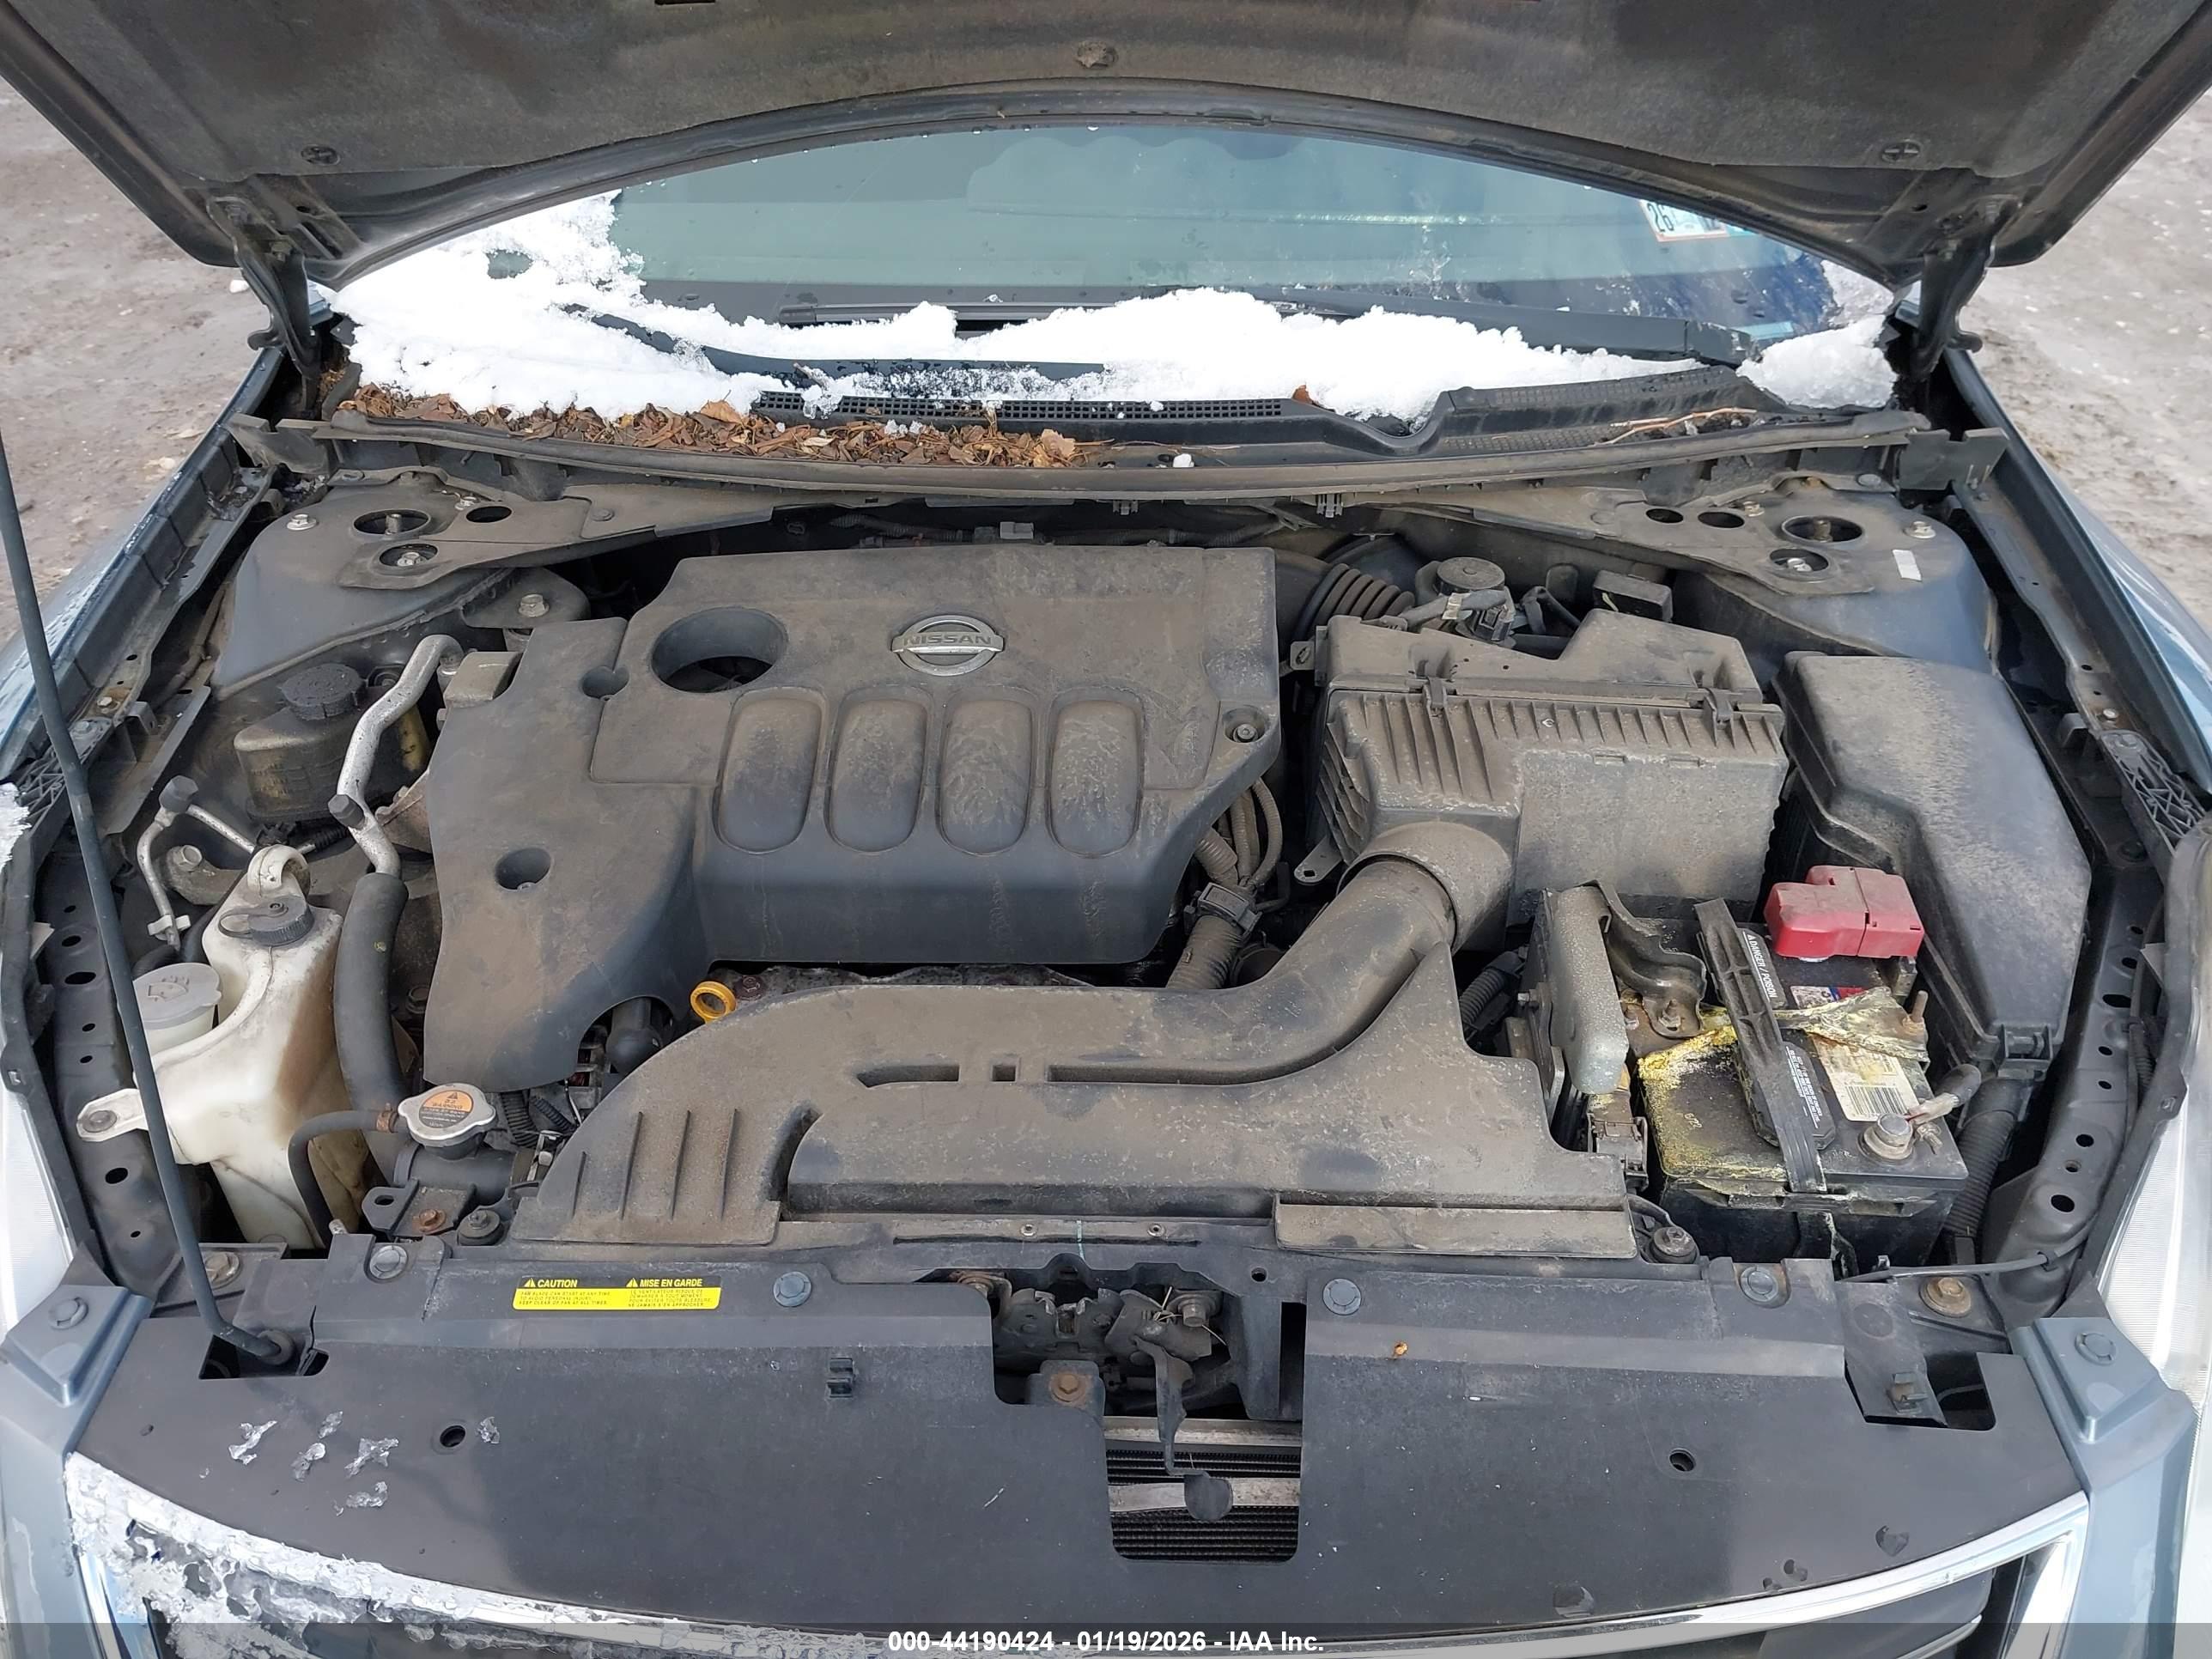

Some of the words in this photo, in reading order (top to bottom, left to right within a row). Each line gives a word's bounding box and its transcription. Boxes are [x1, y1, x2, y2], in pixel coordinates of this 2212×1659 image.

[903, 635, 992, 646] NISSAN
[1748, 940, 1766, 967] DANGER
[1761, 973, 1778, 998] POISON
[537, 1279, 578, 1288] CAUTION
[639, 1279, 660, 1288] MISE
[660, 1279, 673, 1288] EN
[674, 1279, 702, 1287] GARDE
